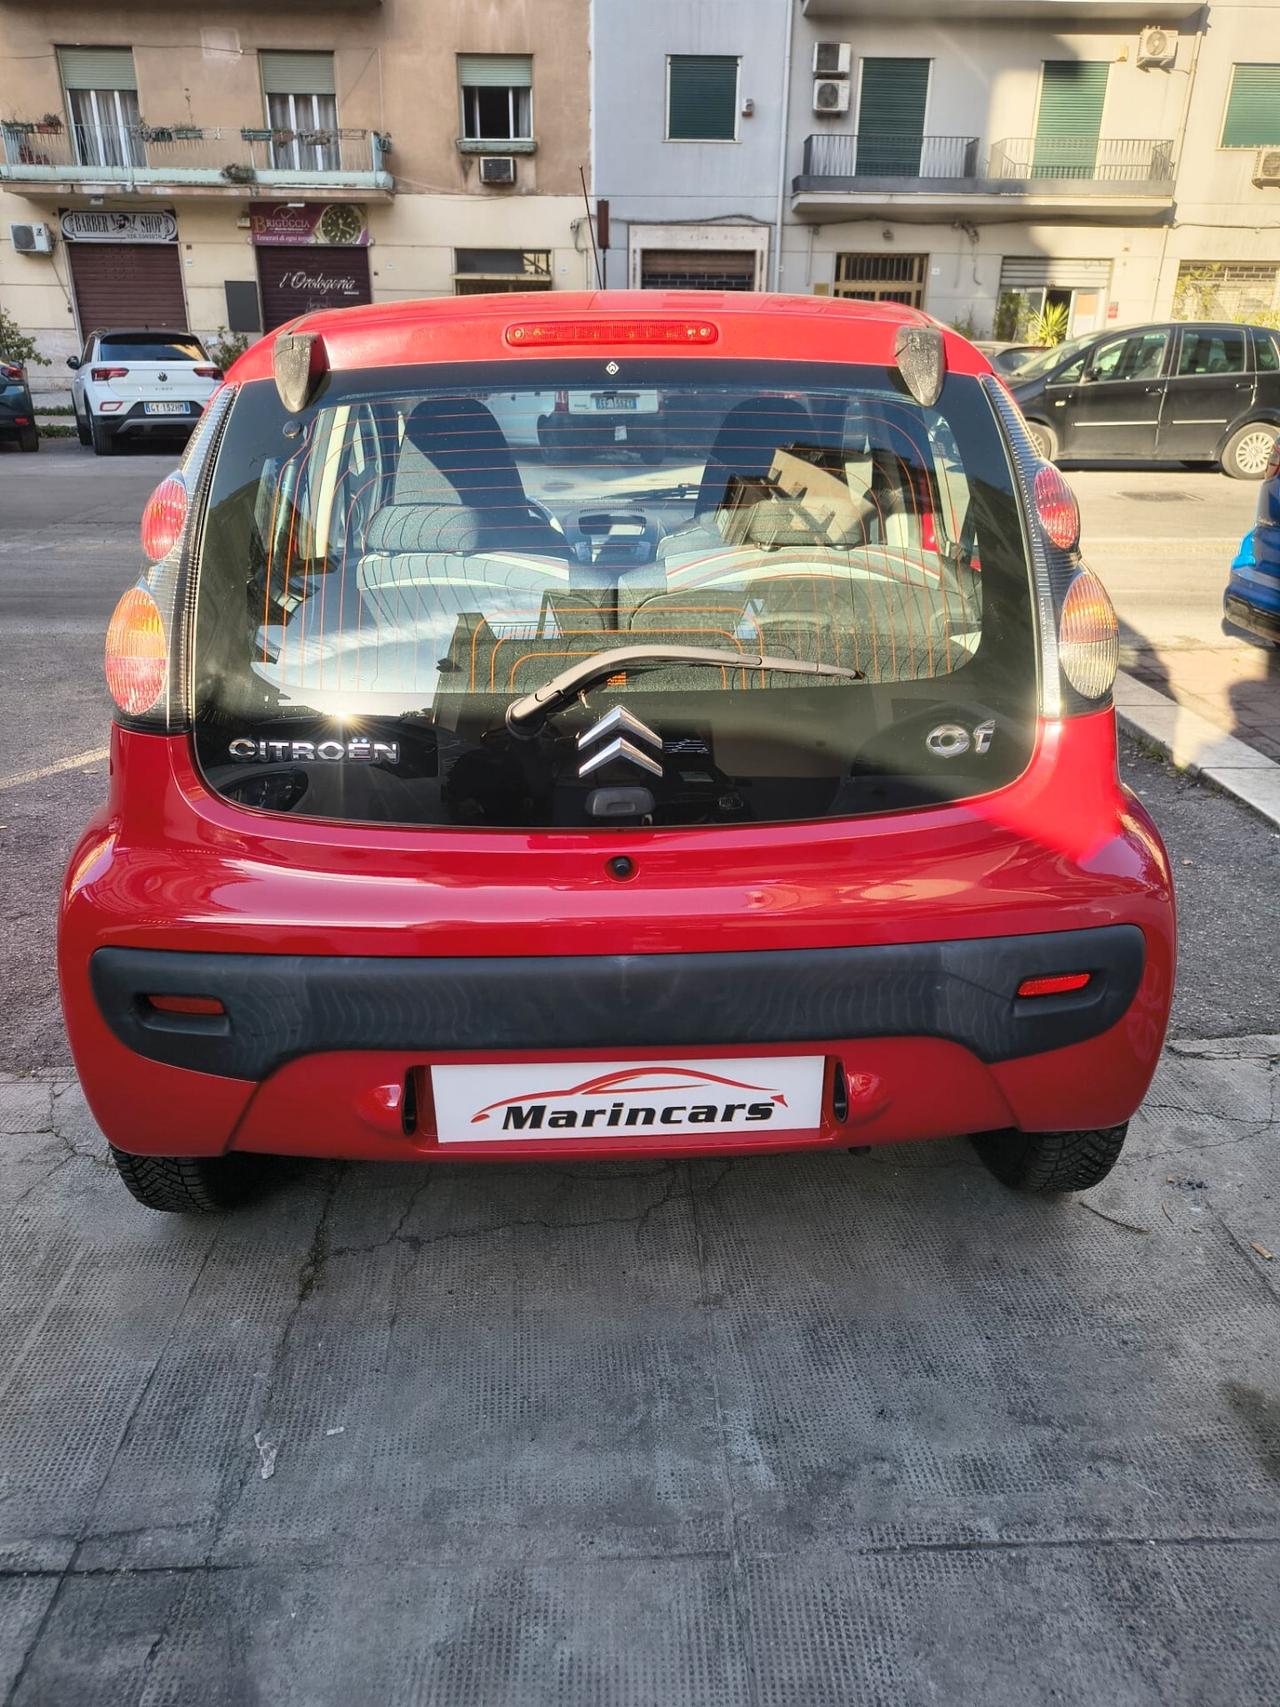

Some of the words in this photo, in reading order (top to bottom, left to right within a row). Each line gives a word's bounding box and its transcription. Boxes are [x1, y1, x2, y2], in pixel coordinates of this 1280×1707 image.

[75, 214, 109, 233] BARBER
[141, 215, 163, 233] SHOP
[252, 215, 310, 234] BRIGUCCIA
[228, 737, 397, 761] CITROËN
[502, 1101, 776, 1130] Marincars
